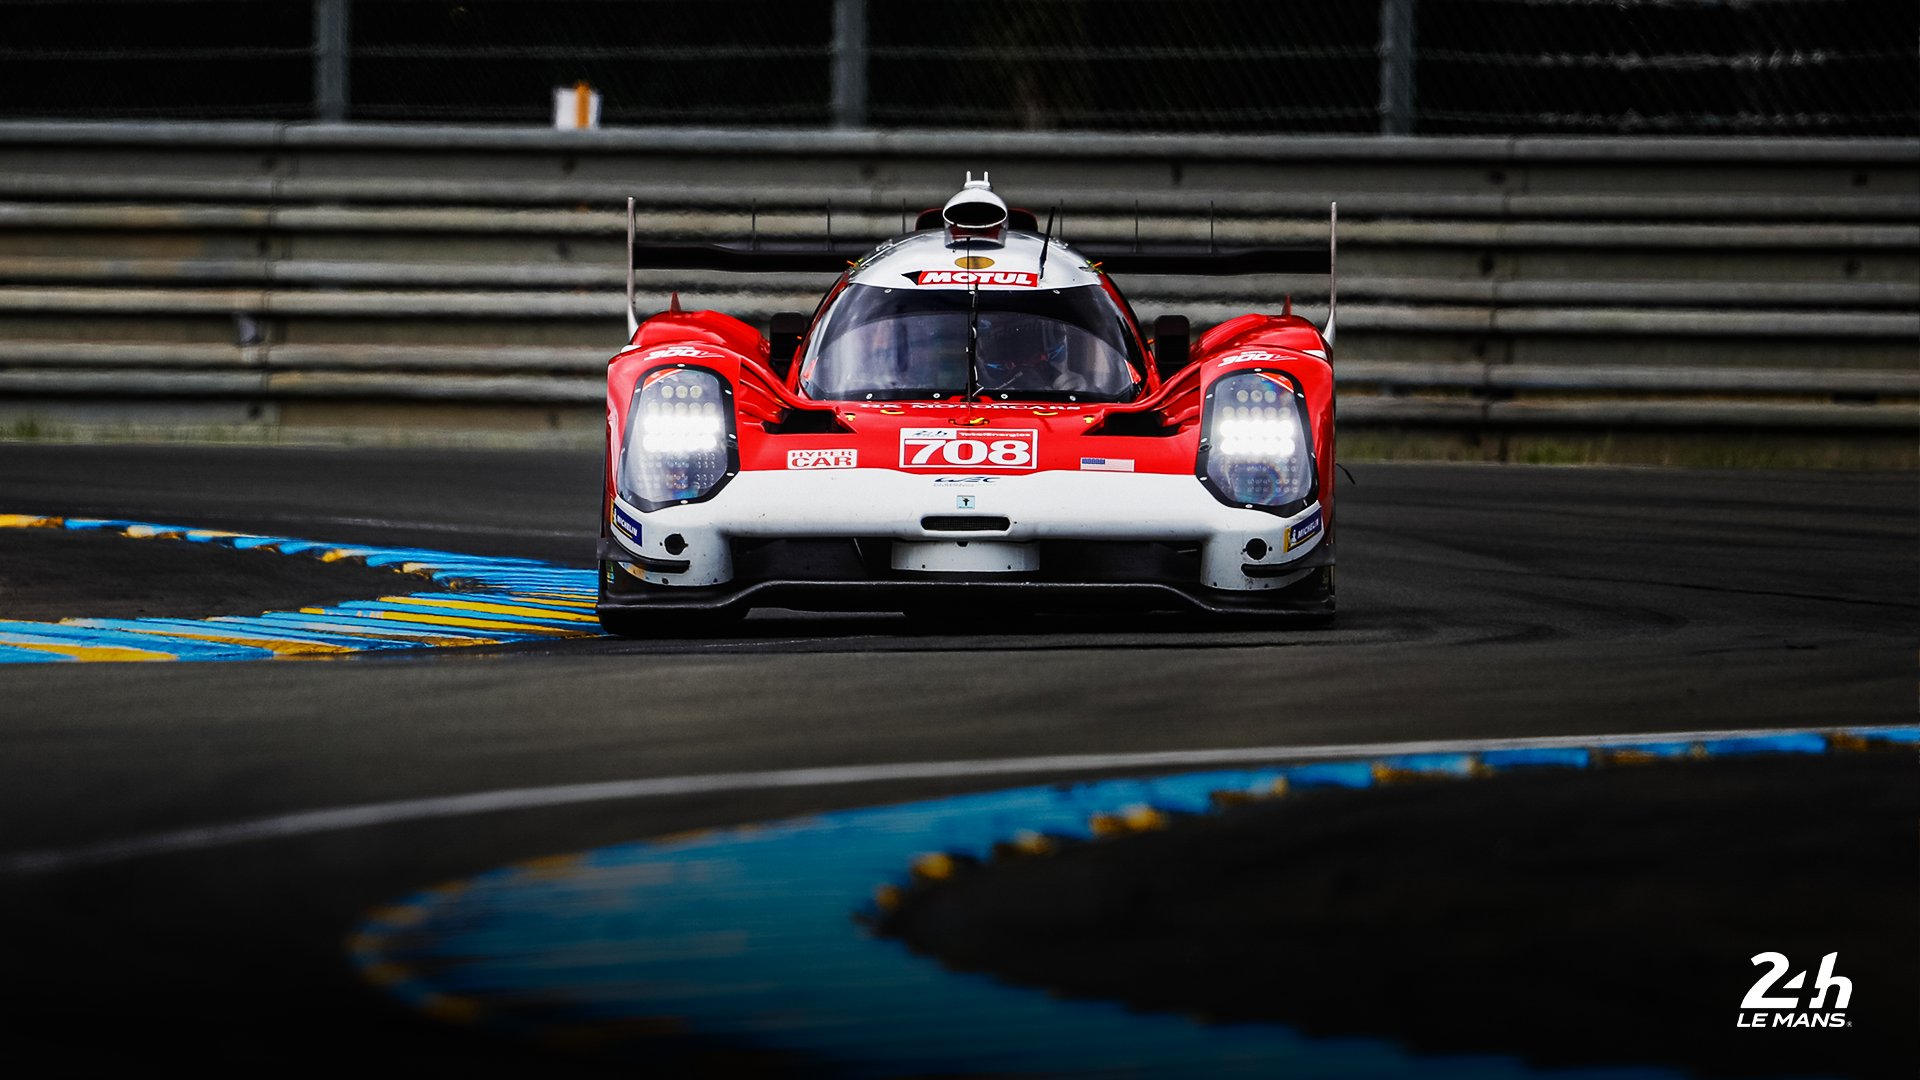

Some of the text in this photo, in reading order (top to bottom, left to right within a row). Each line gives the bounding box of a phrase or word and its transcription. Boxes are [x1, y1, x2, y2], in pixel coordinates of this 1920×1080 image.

[922, 271, 1032, 285] MOTUL
[904, 439, 1031, 465] 708
[791, 457, 852, 467] CAR
[616, 514, 638, 537] MICHELIN
